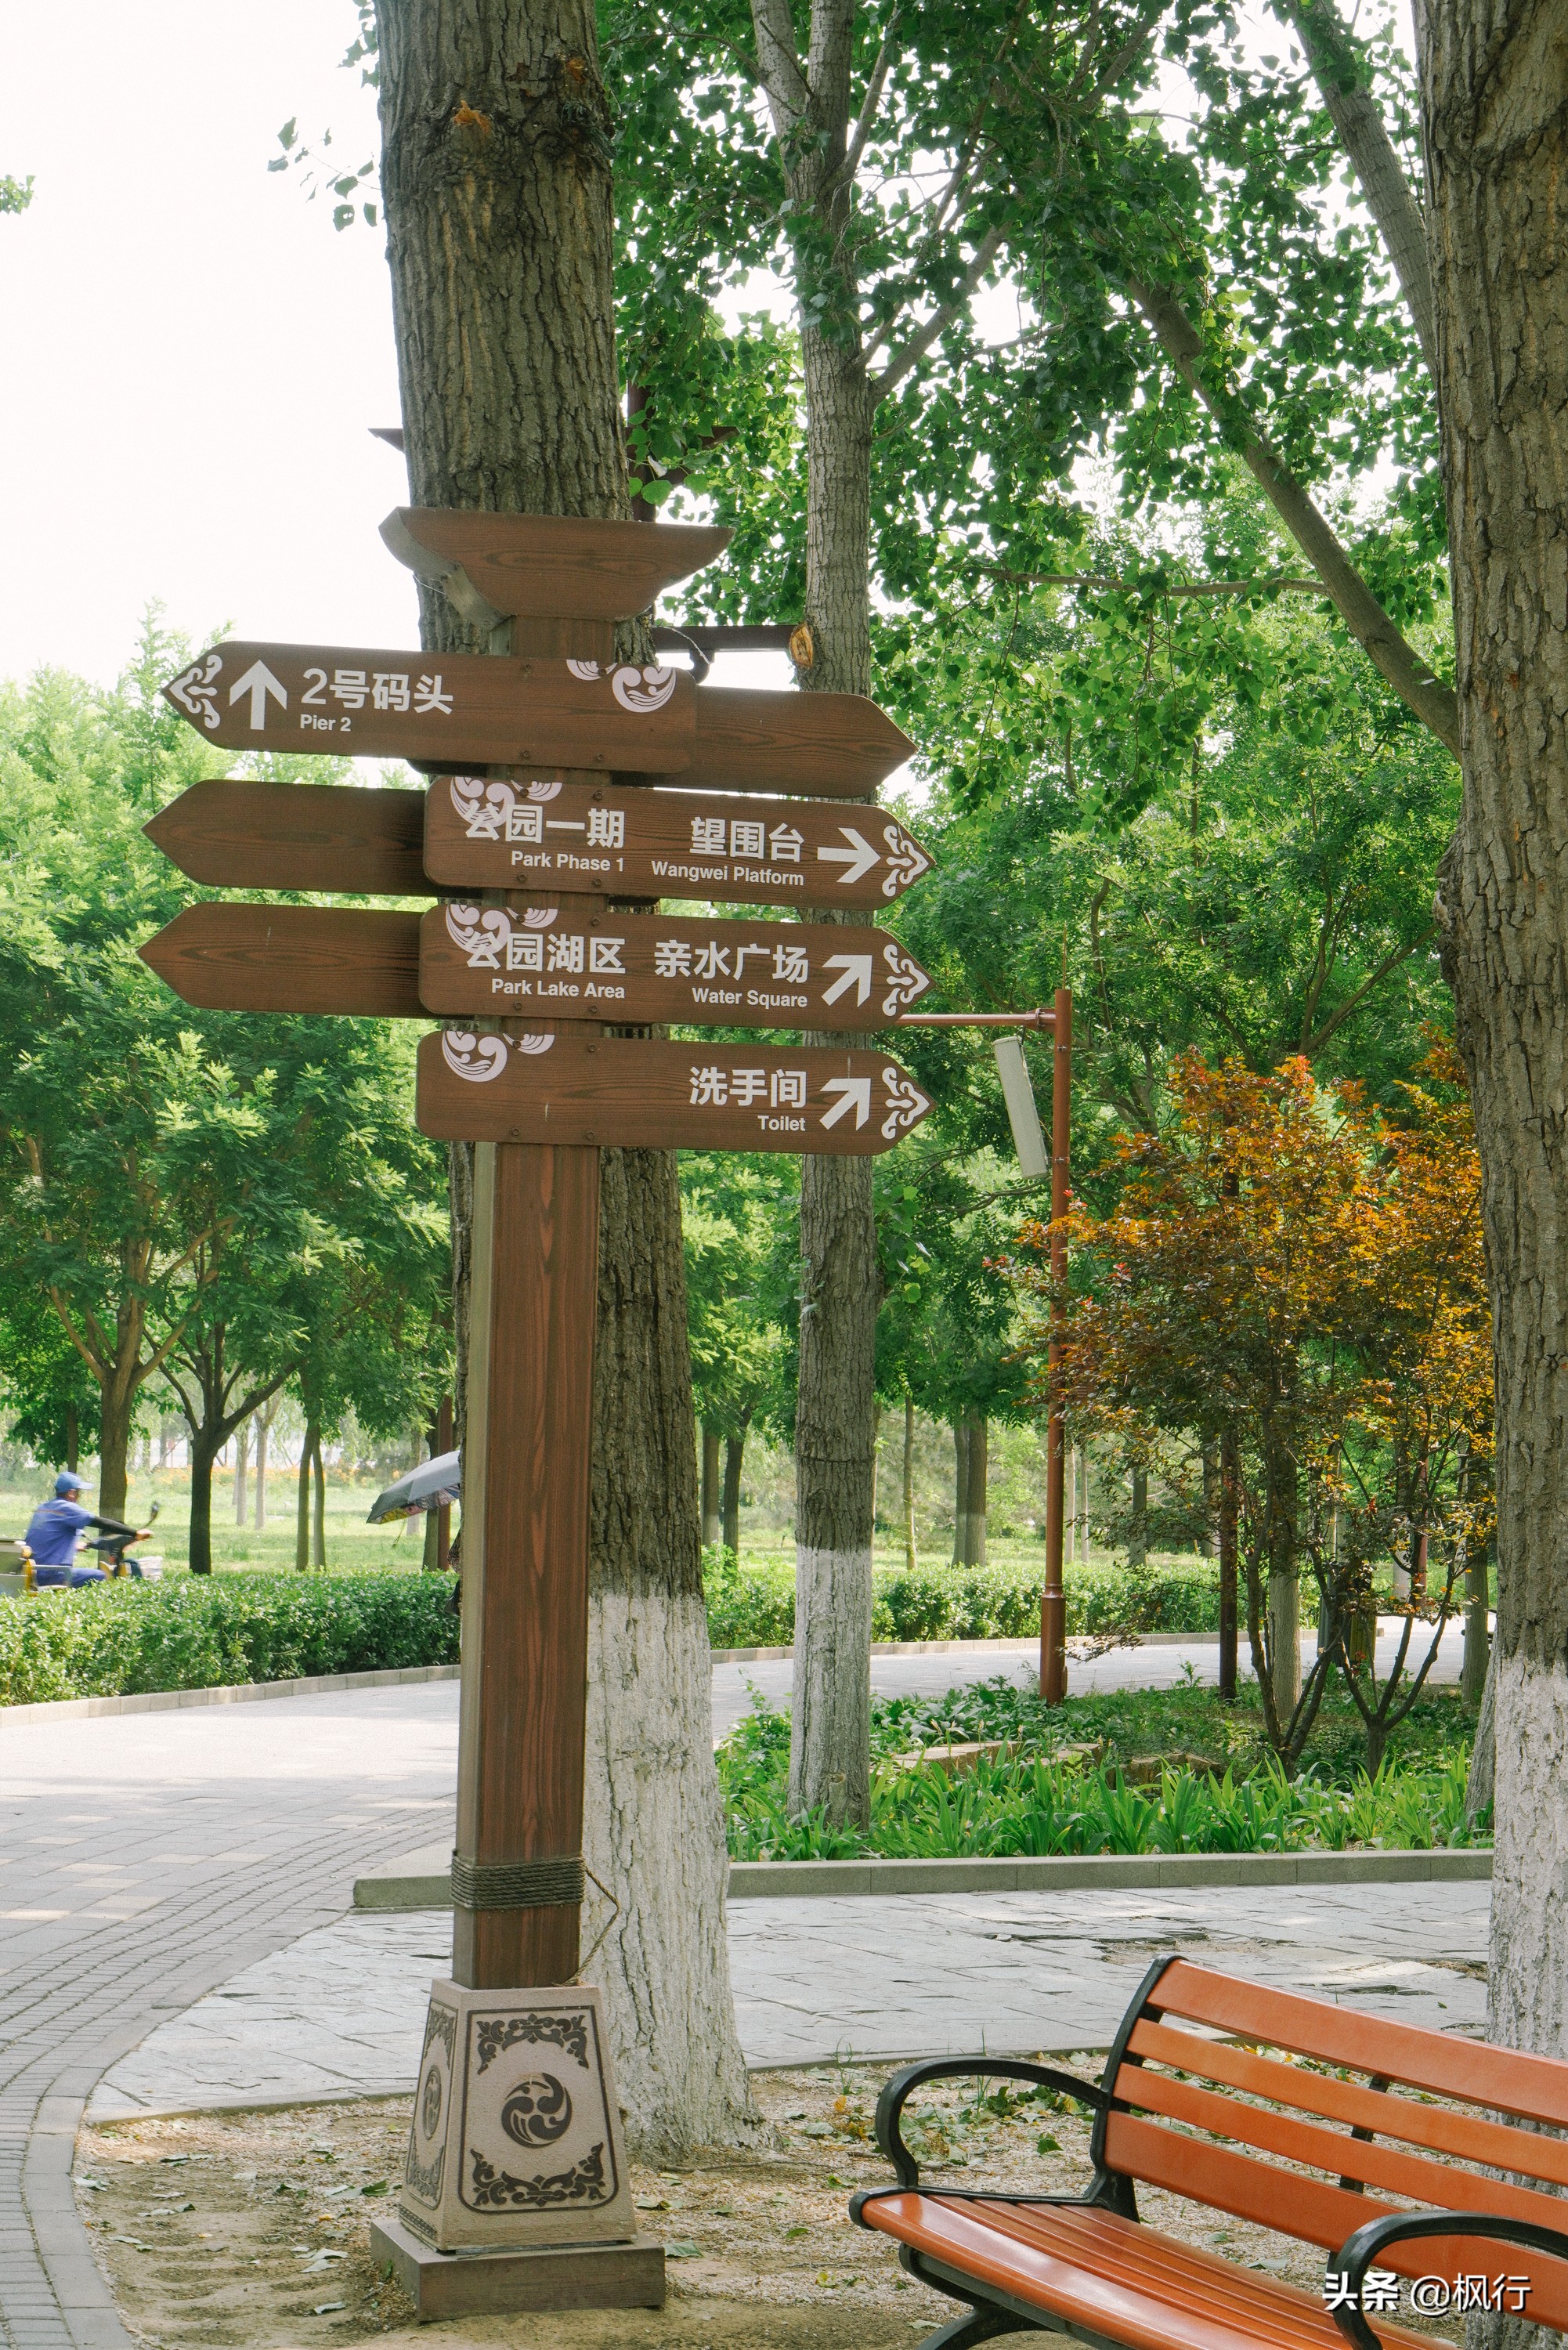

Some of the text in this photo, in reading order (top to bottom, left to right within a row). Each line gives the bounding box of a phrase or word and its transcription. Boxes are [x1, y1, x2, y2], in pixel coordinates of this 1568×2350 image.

[302, 668, 454, 714] 2号码头
[300, 714, 352, 732] Pier 2
[464, 800, 626, 849] 公园一期
[689, 816, 805, 862] 望围台
[511, 851, 623, 872] Park Phase 1
[651, 860, 804, 886] Wangwei Platform
[465, 931, 626, 974] 公园湖区
[653, 940, 809, 984] 亲水广场
[491, 978, 626, 999] Park Lake Area
[692, 988, 808, 1009] Water Square
[688, 1066, 807, 1108] 洗手间
[757, 1115, 806, 1131] Toilet
